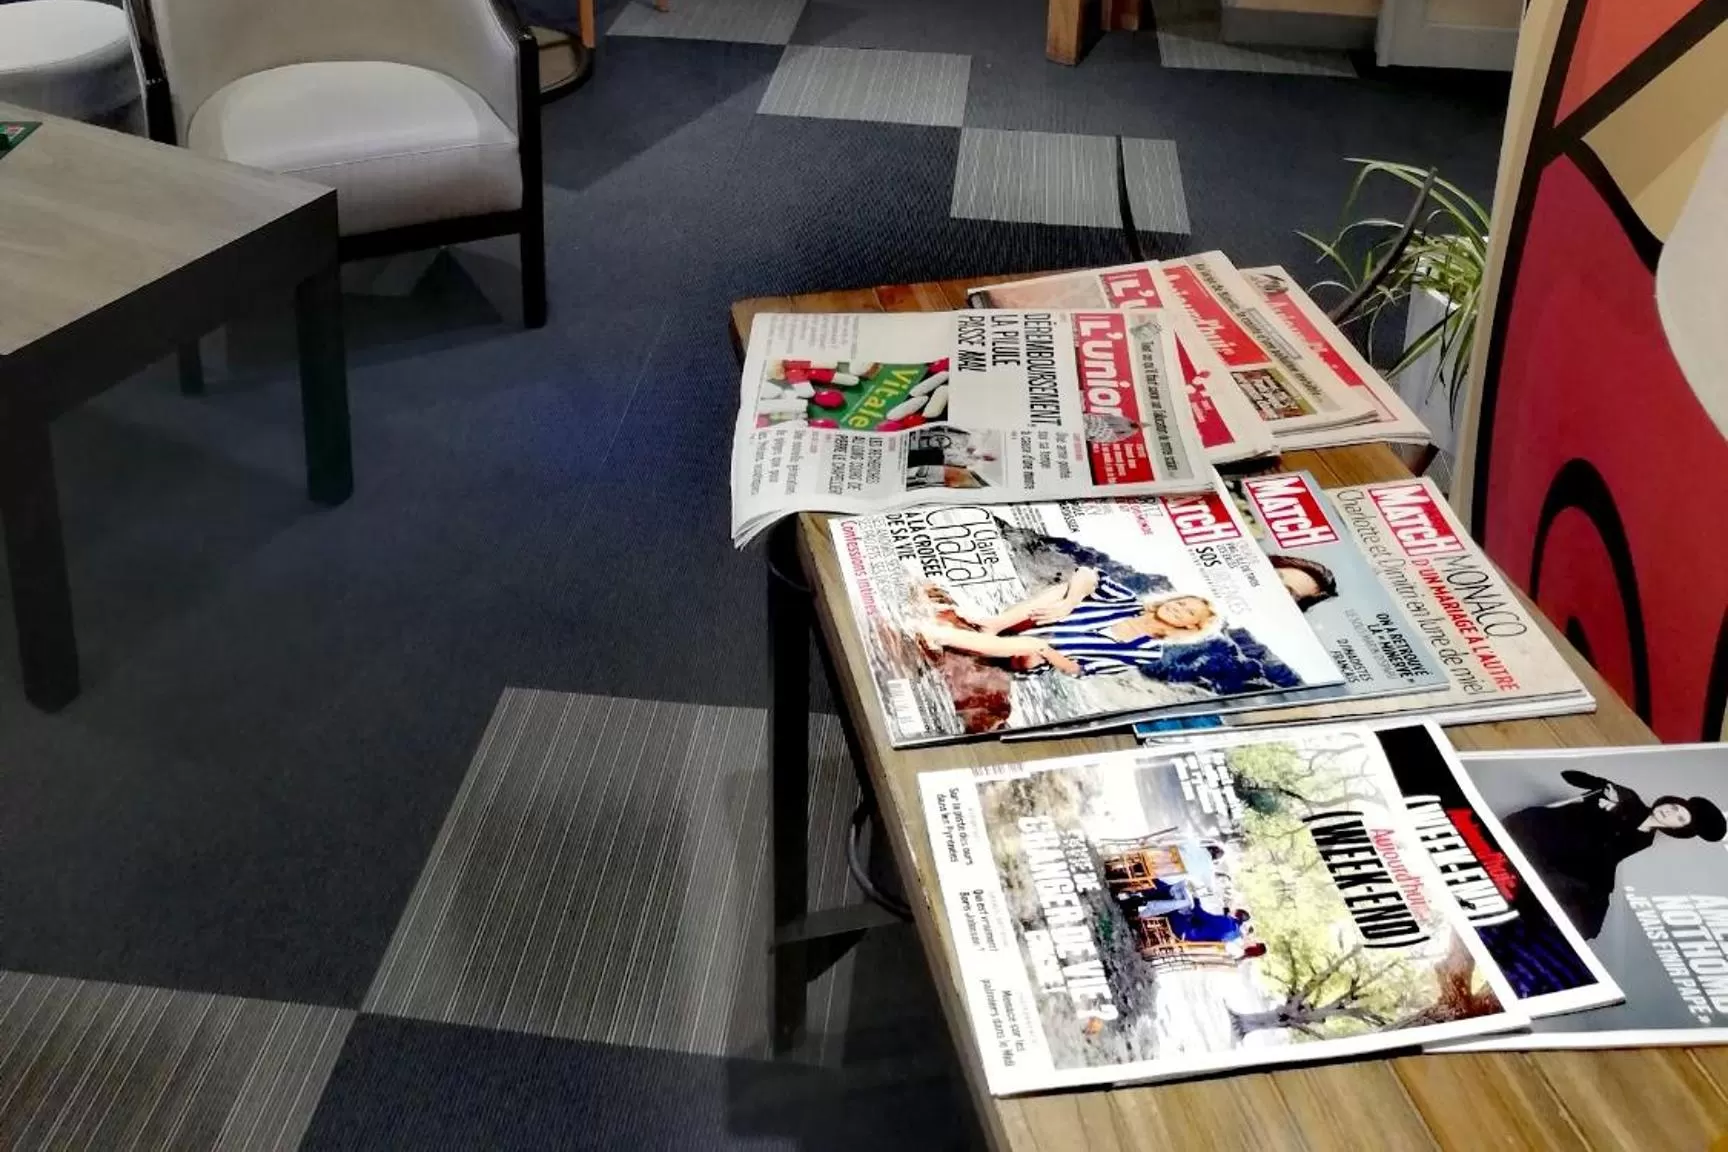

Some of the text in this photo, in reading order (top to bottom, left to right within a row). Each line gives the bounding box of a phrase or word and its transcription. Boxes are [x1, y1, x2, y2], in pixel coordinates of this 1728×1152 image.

[957, 314, 987, 373] PASSE MAL
[991, 314, 1020, 366] LA PILULE
[849, 366, 920, 430] Vitale
[886, 513, 905, 527] DE
[907, 519, 927, 534] LA
[1247, 476, 1336, 547] MATCH
[1336, 489, 1383, 542] Charlotte
[1370, 484, 1463, 556] MATCH
[890, 528, 910, 543] SA
[895, 543, 917, 561] VIE
[926, 505, 1016, 589] Chazal
[972, 527, 1000, 565] Claire
[1195, 546, 1222, 568] SOS
[1405, 600, 1431, 618] en
[1434, 554, 1528, 638] MONACO
[1416, 616, 1451, 652] lune
[1431, 586, 1479, 634] MARIAGE
[1472, 646, 1521, 693] L'AUTRE
[1438, 648, 1466, 667] de
[1449, 664, 1497, 696] miel
[1018, 816, 1085, 922] CHANGER
[1302, 811, 1431, 949] (WEEK-END)
[1051, 924, 1099, 959] DE
[1062, 959, 1113, 1003] VIE
